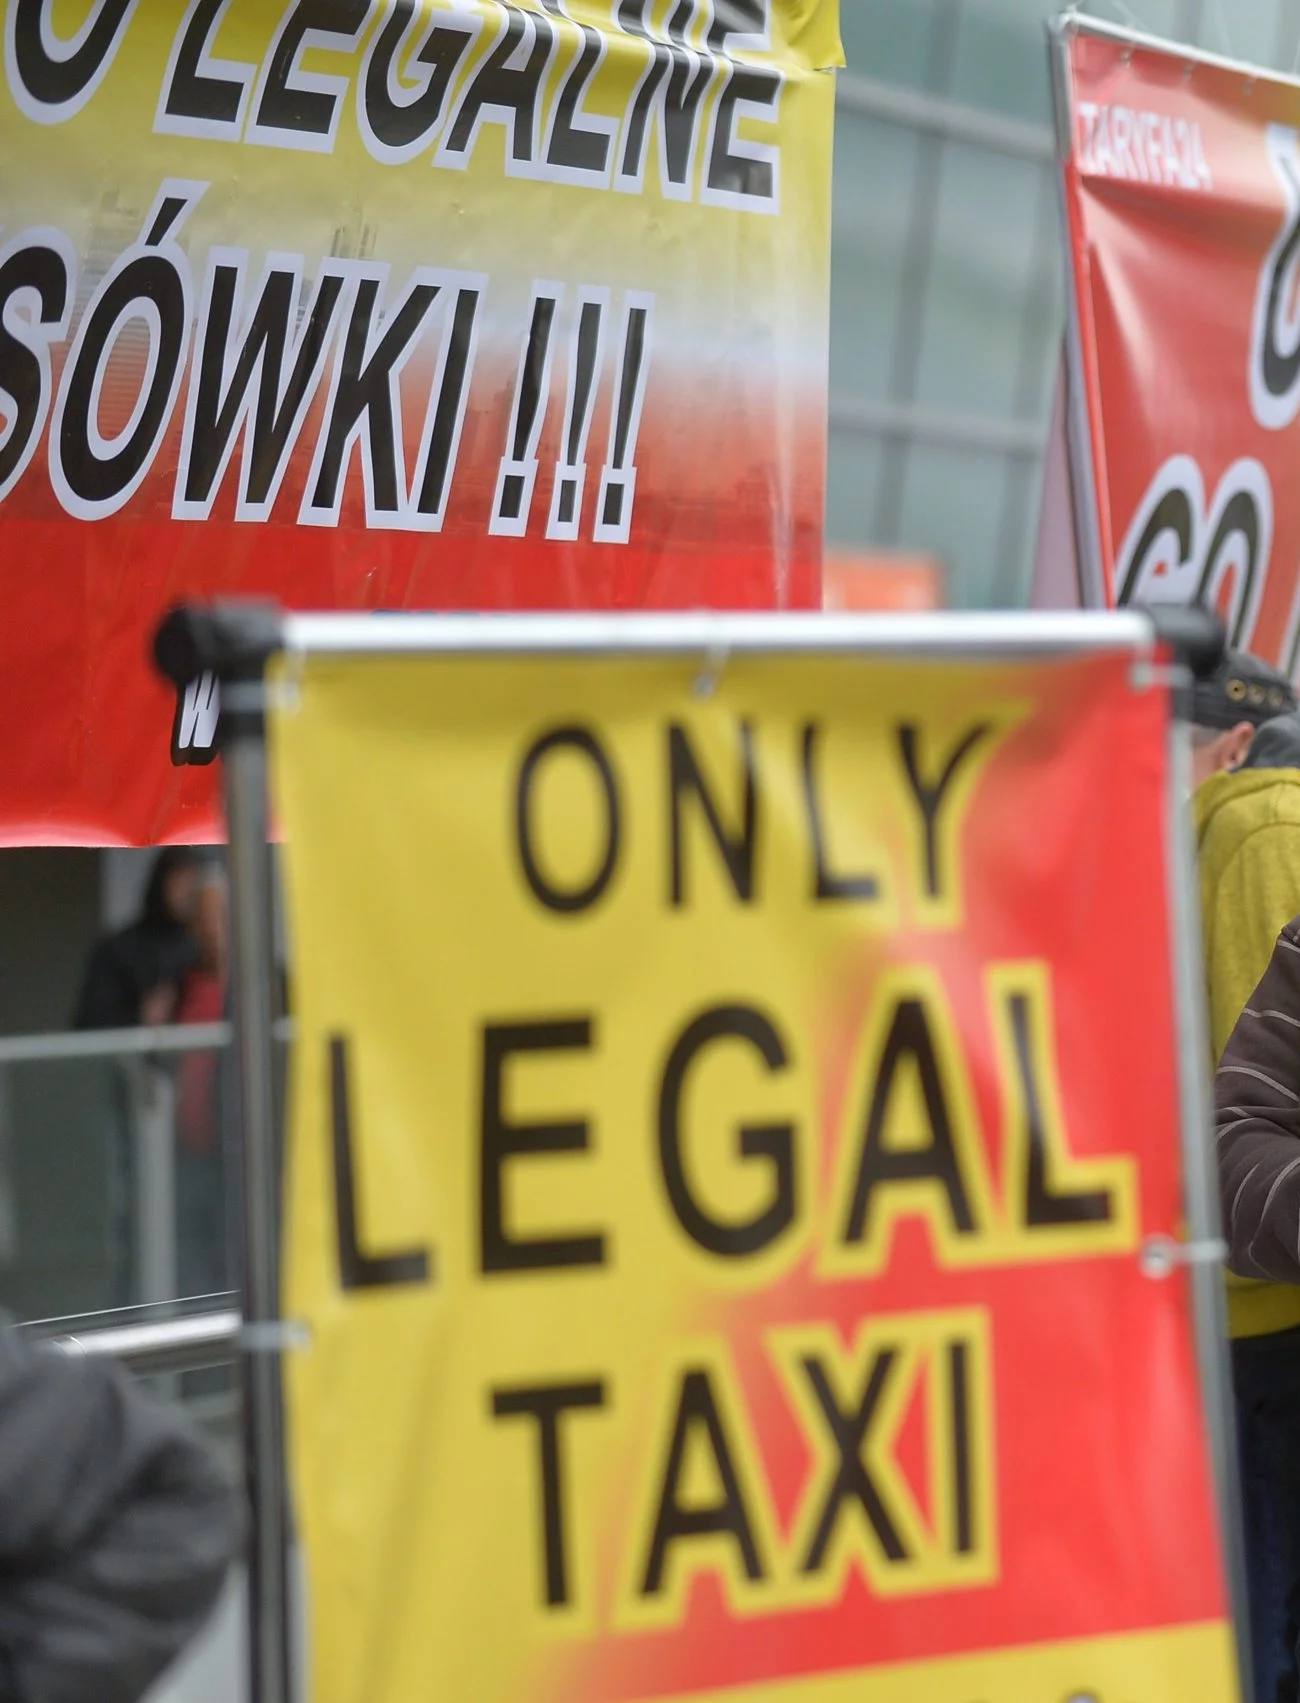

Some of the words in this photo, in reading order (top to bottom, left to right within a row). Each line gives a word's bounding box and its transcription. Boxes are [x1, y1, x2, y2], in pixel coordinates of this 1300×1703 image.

[514, 719, 996, 919] ONLY
[325, 985, 1117, 1292] LEGAL
[487, 1337, 979, 1611] TAXI
